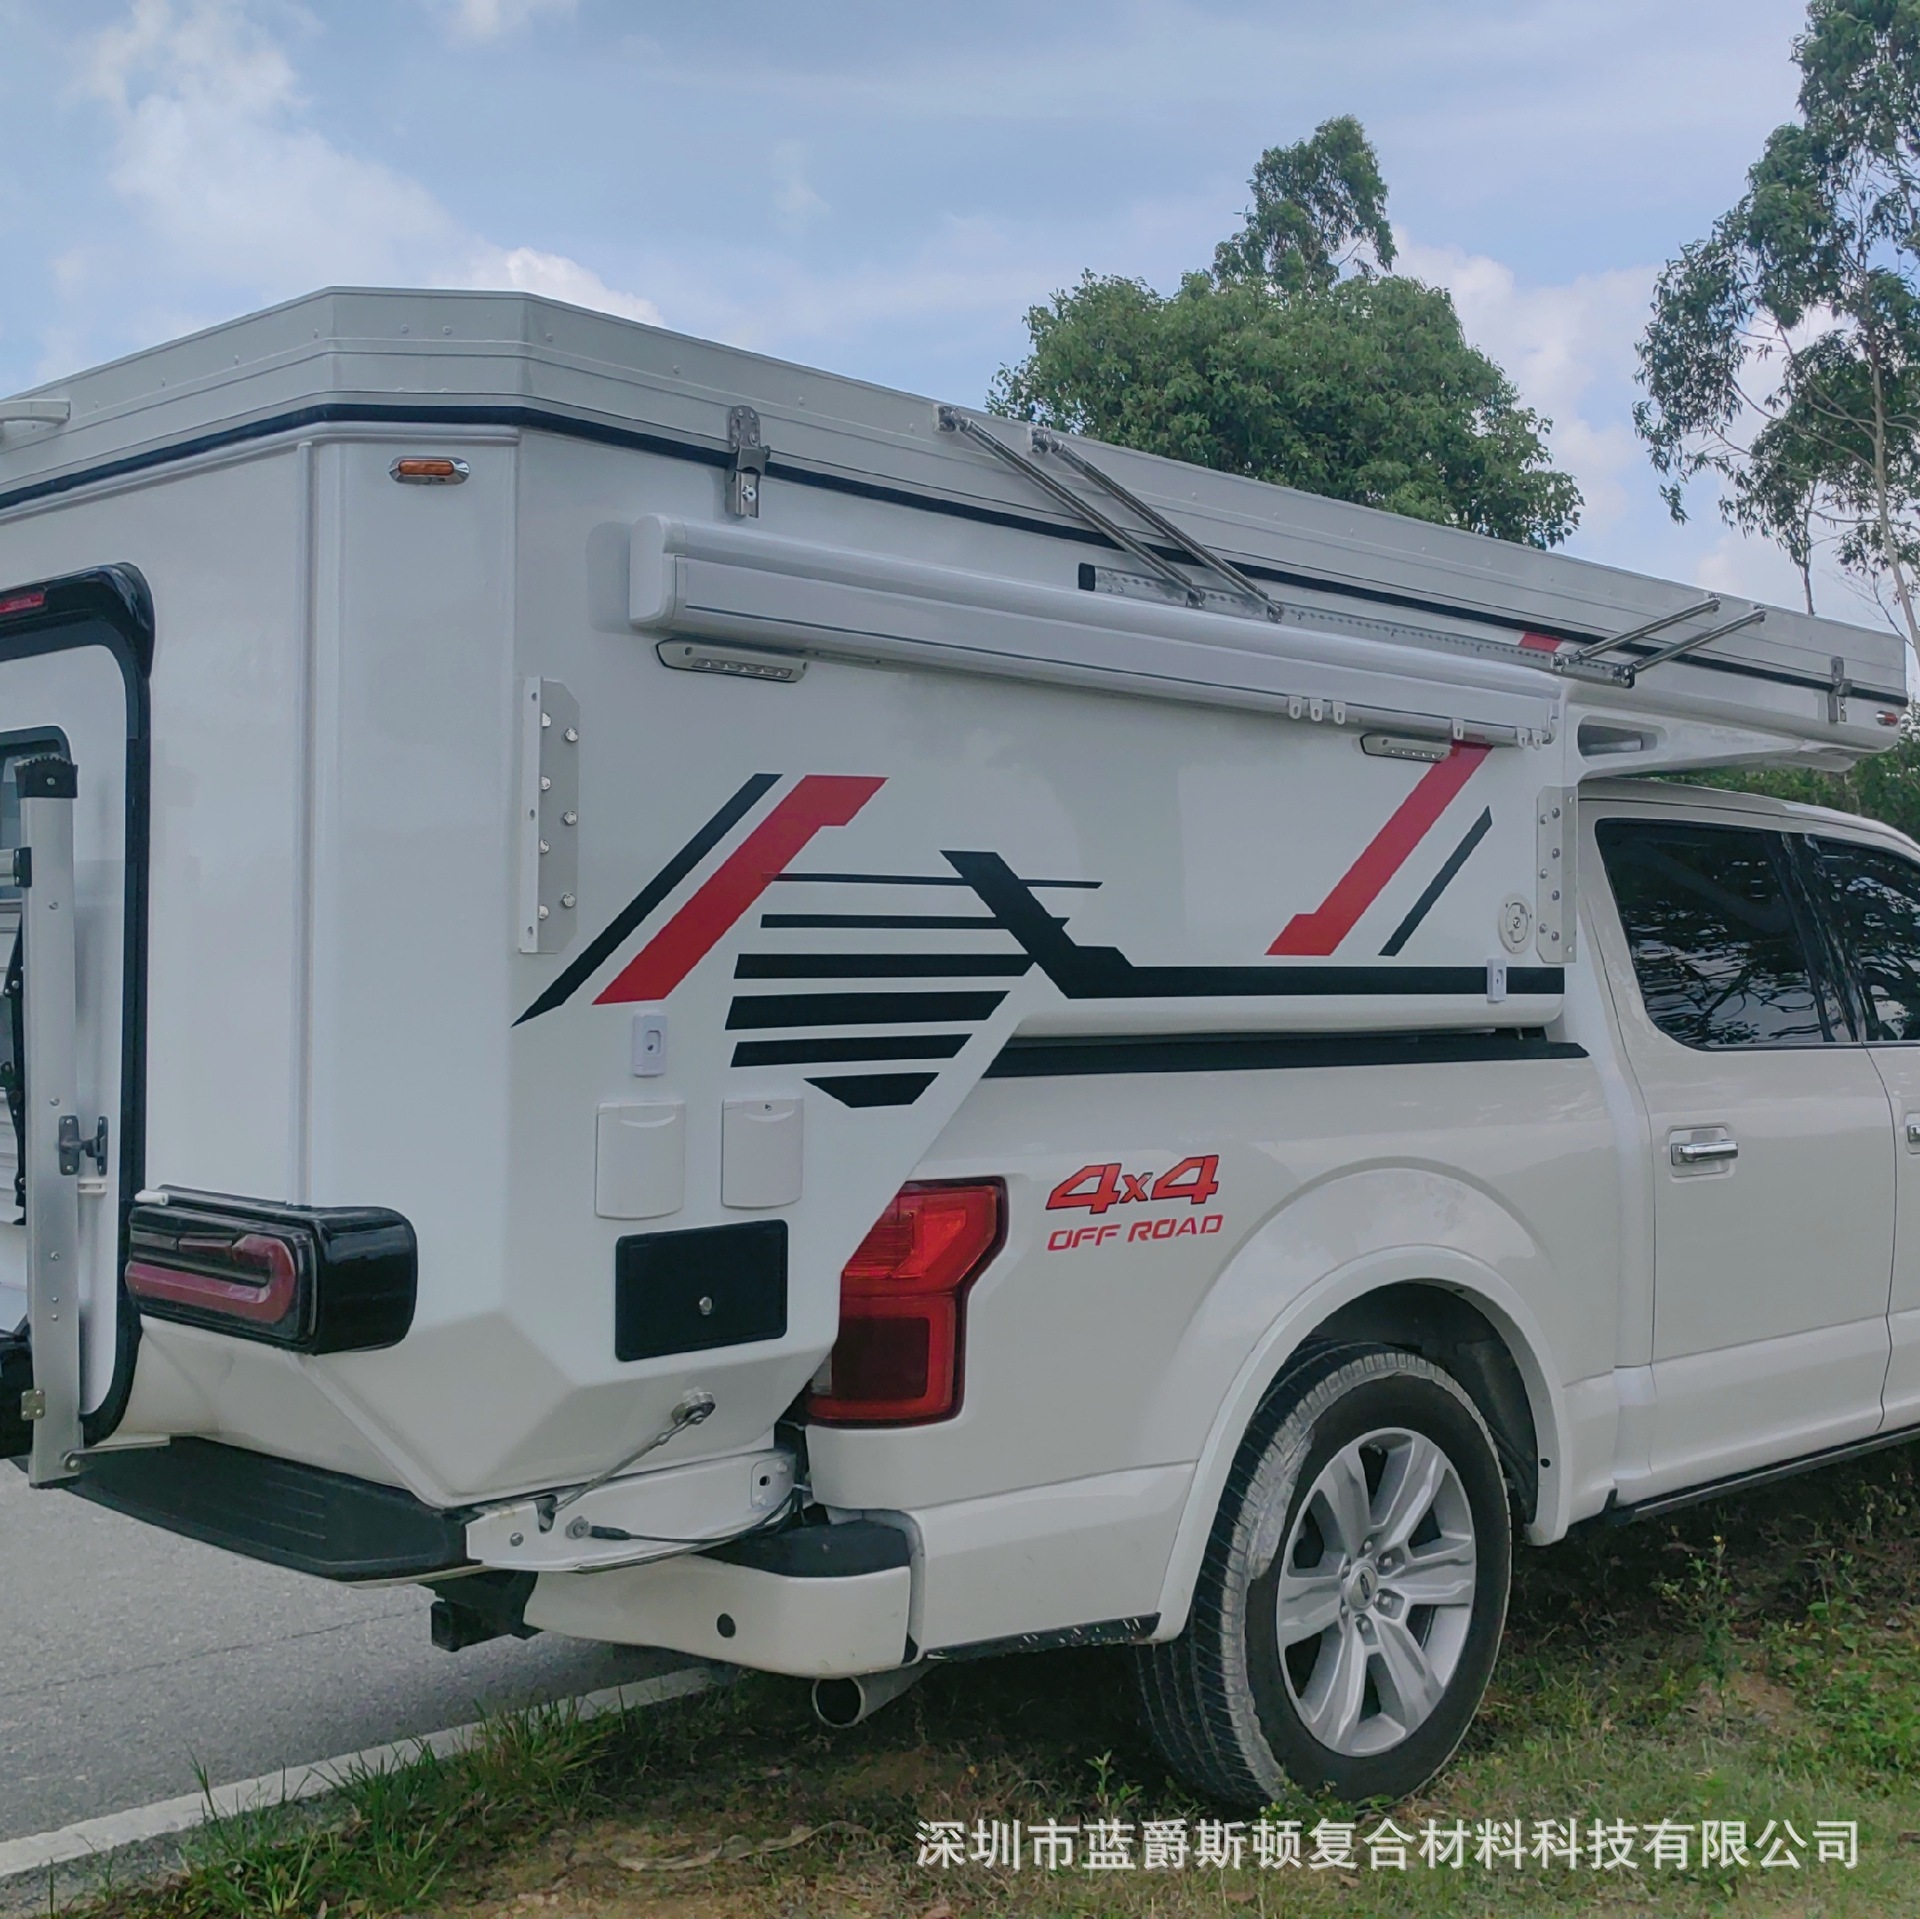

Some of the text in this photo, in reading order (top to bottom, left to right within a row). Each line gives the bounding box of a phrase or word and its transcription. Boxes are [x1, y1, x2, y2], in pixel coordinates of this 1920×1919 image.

[1045, 1154, 1219, 1214] 4x4
[1047, 1214, 1223, 1250] OFF ROAD
